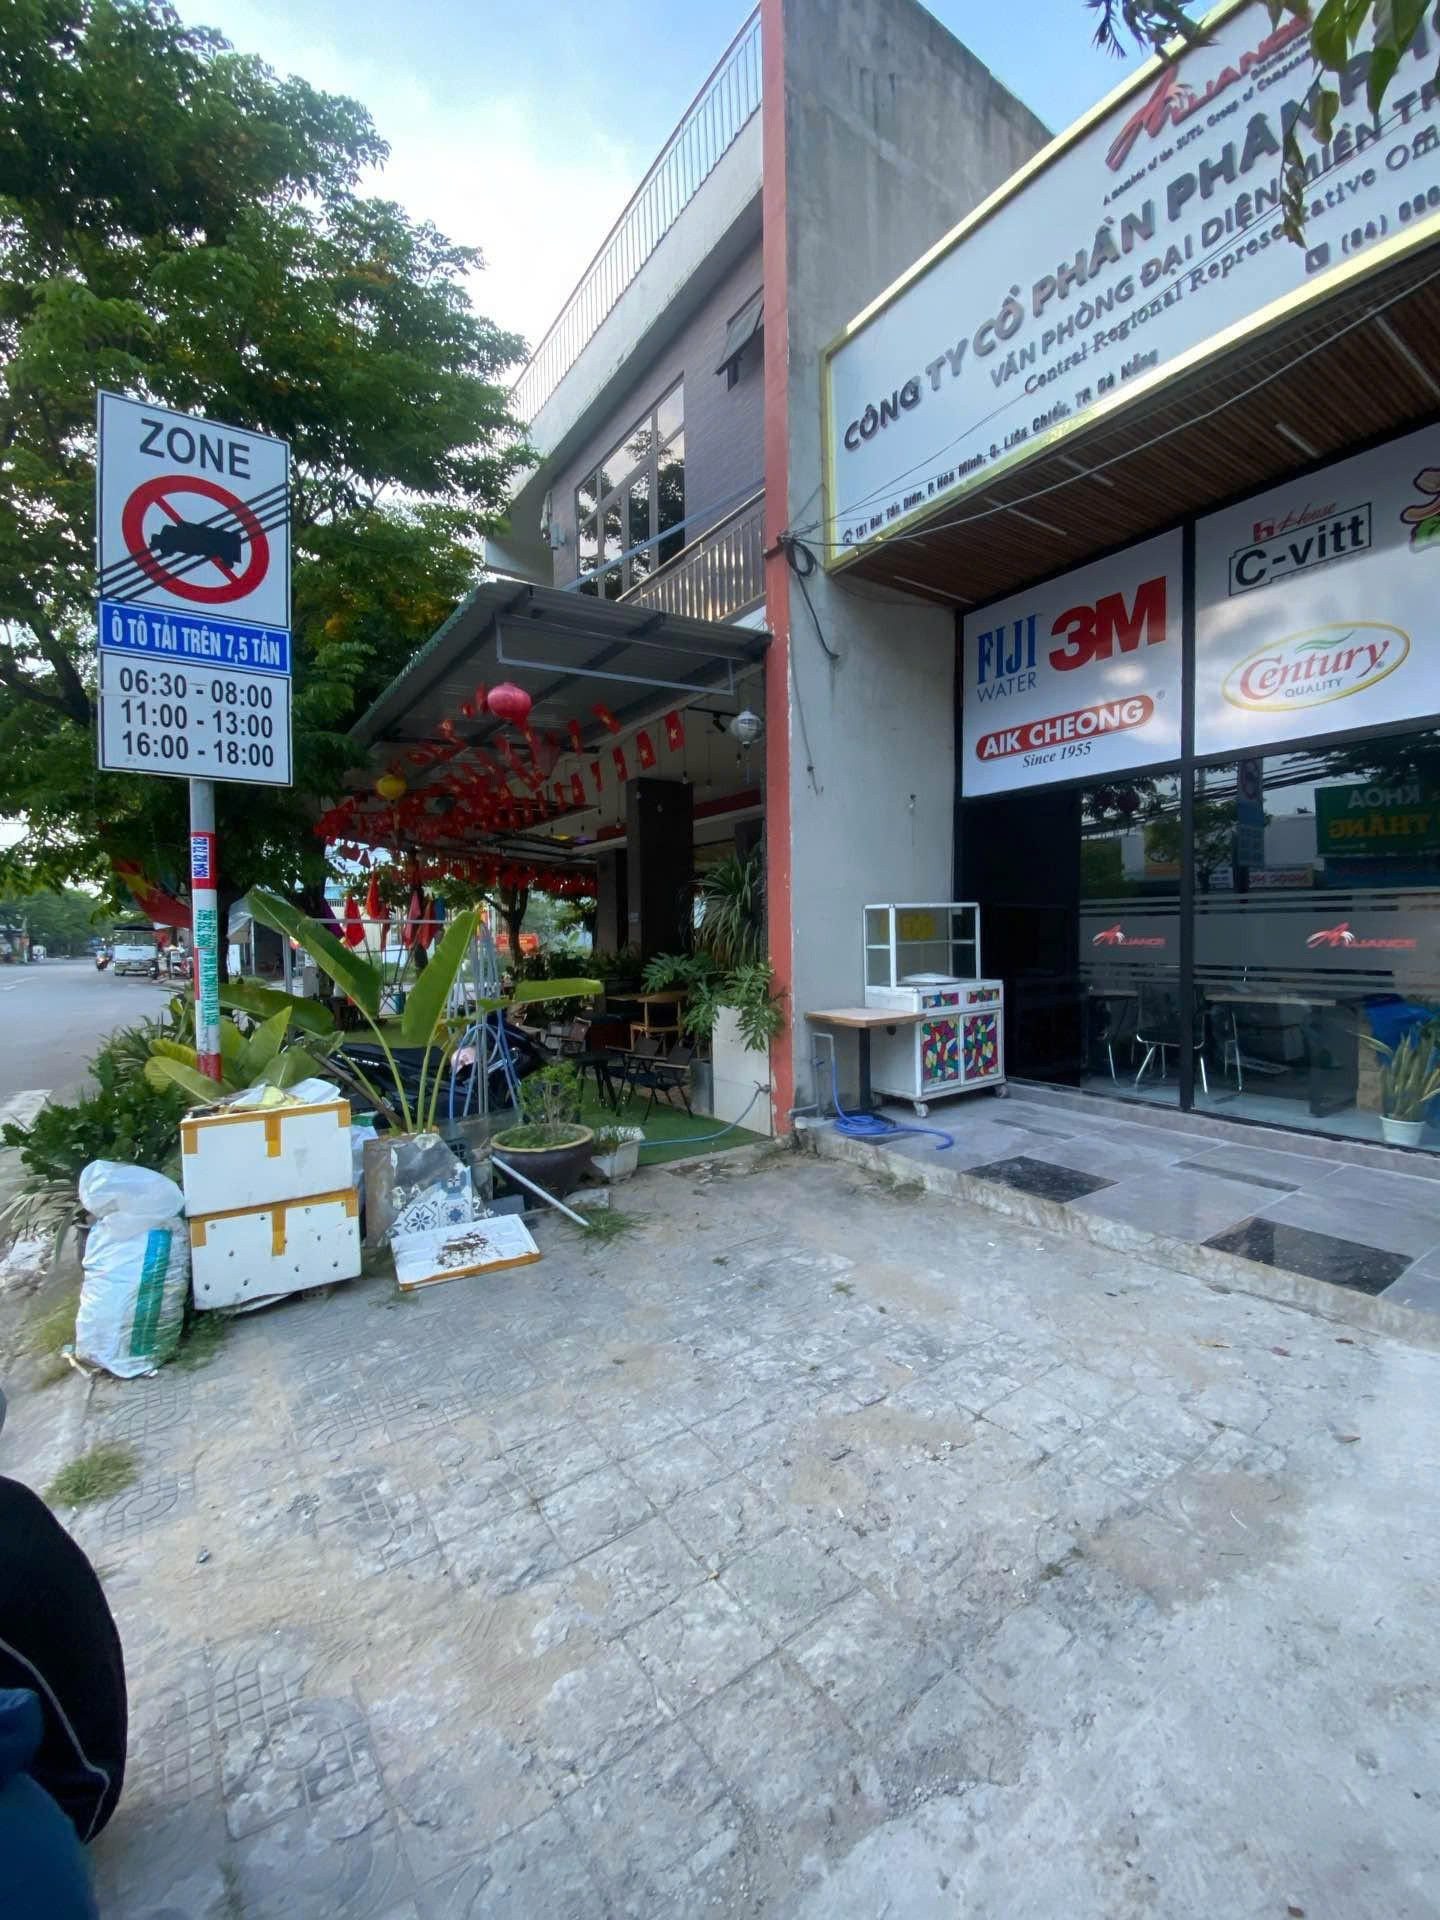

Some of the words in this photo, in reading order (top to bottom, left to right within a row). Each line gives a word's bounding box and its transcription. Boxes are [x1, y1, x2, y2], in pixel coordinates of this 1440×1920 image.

[1042, 275, 1134, 355] PHÒNG
[1140, 234, 1192, 288] ĐẠI
[1201, 178, 1279, 249] DIỆN
[1024, 342, 1089, 394] Central
[1093, 279, 1184, 353] Regional
[844, 375, 921, 452] CÔNG
[926, 338, 969, 392] TY
[140, 418, 251, 480] ZONE
[1235, 515, 1365, 586] C-vitt
[112, 610, 123, 643] Ô
[128, 614, 148, 648] TÔ
[152, 615, 177, 651] TẢI
[181, 624, 222, 658] TRÊN
[225, 634, 248, 664] 7,5
[252, 631, 280, 666] TẤN
[977, 614, 1037, 685] FIJI
[1049, 575, 1167, 671] 3M
[119, 667, 187, 699] 06:30
[211, 679, 272, 710] 08:00
[977, 671, 1037, 703] WATER
[1239, 640, 1390, 701] Century
[1284, 676, 1344, 699] QUALITY
[121, 699, 188, 730] 11:00
[212, 709, 273, 739] 13:00
[983, 730, 1022, 758] AIK
[1029, 699, 1144, 746] CHEONG
[122, 731, 189, 760] 16:00
[213, 739, 274, 768] 18:00
[1022, 752, 1057, 768] Since
[1060, 741, 1092, 761] 1955
